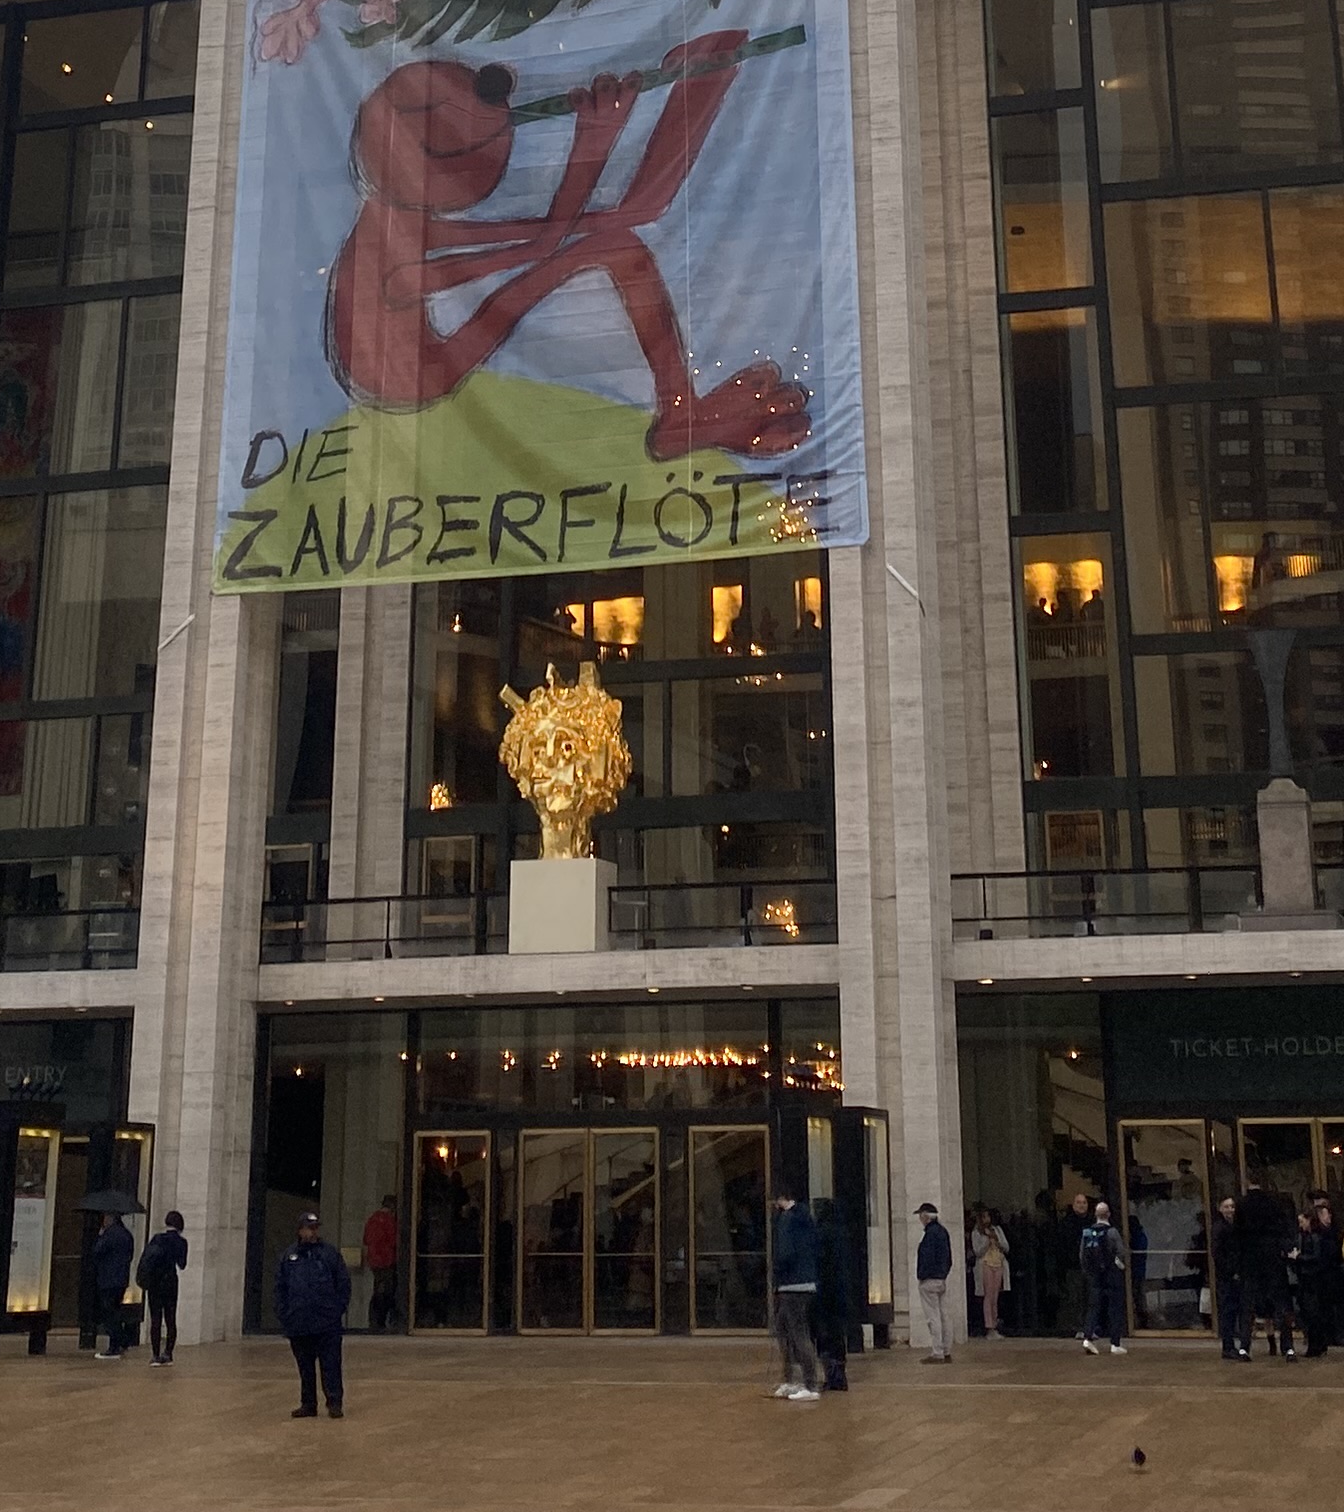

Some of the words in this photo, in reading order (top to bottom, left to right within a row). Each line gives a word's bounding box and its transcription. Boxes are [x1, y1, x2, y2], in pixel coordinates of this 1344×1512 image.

[241, 425, 360, 488] DIE
[222, 470, 839, 581] ZAUBERFLÖTE
[4, 1064, 68, 1085] ENTRY
